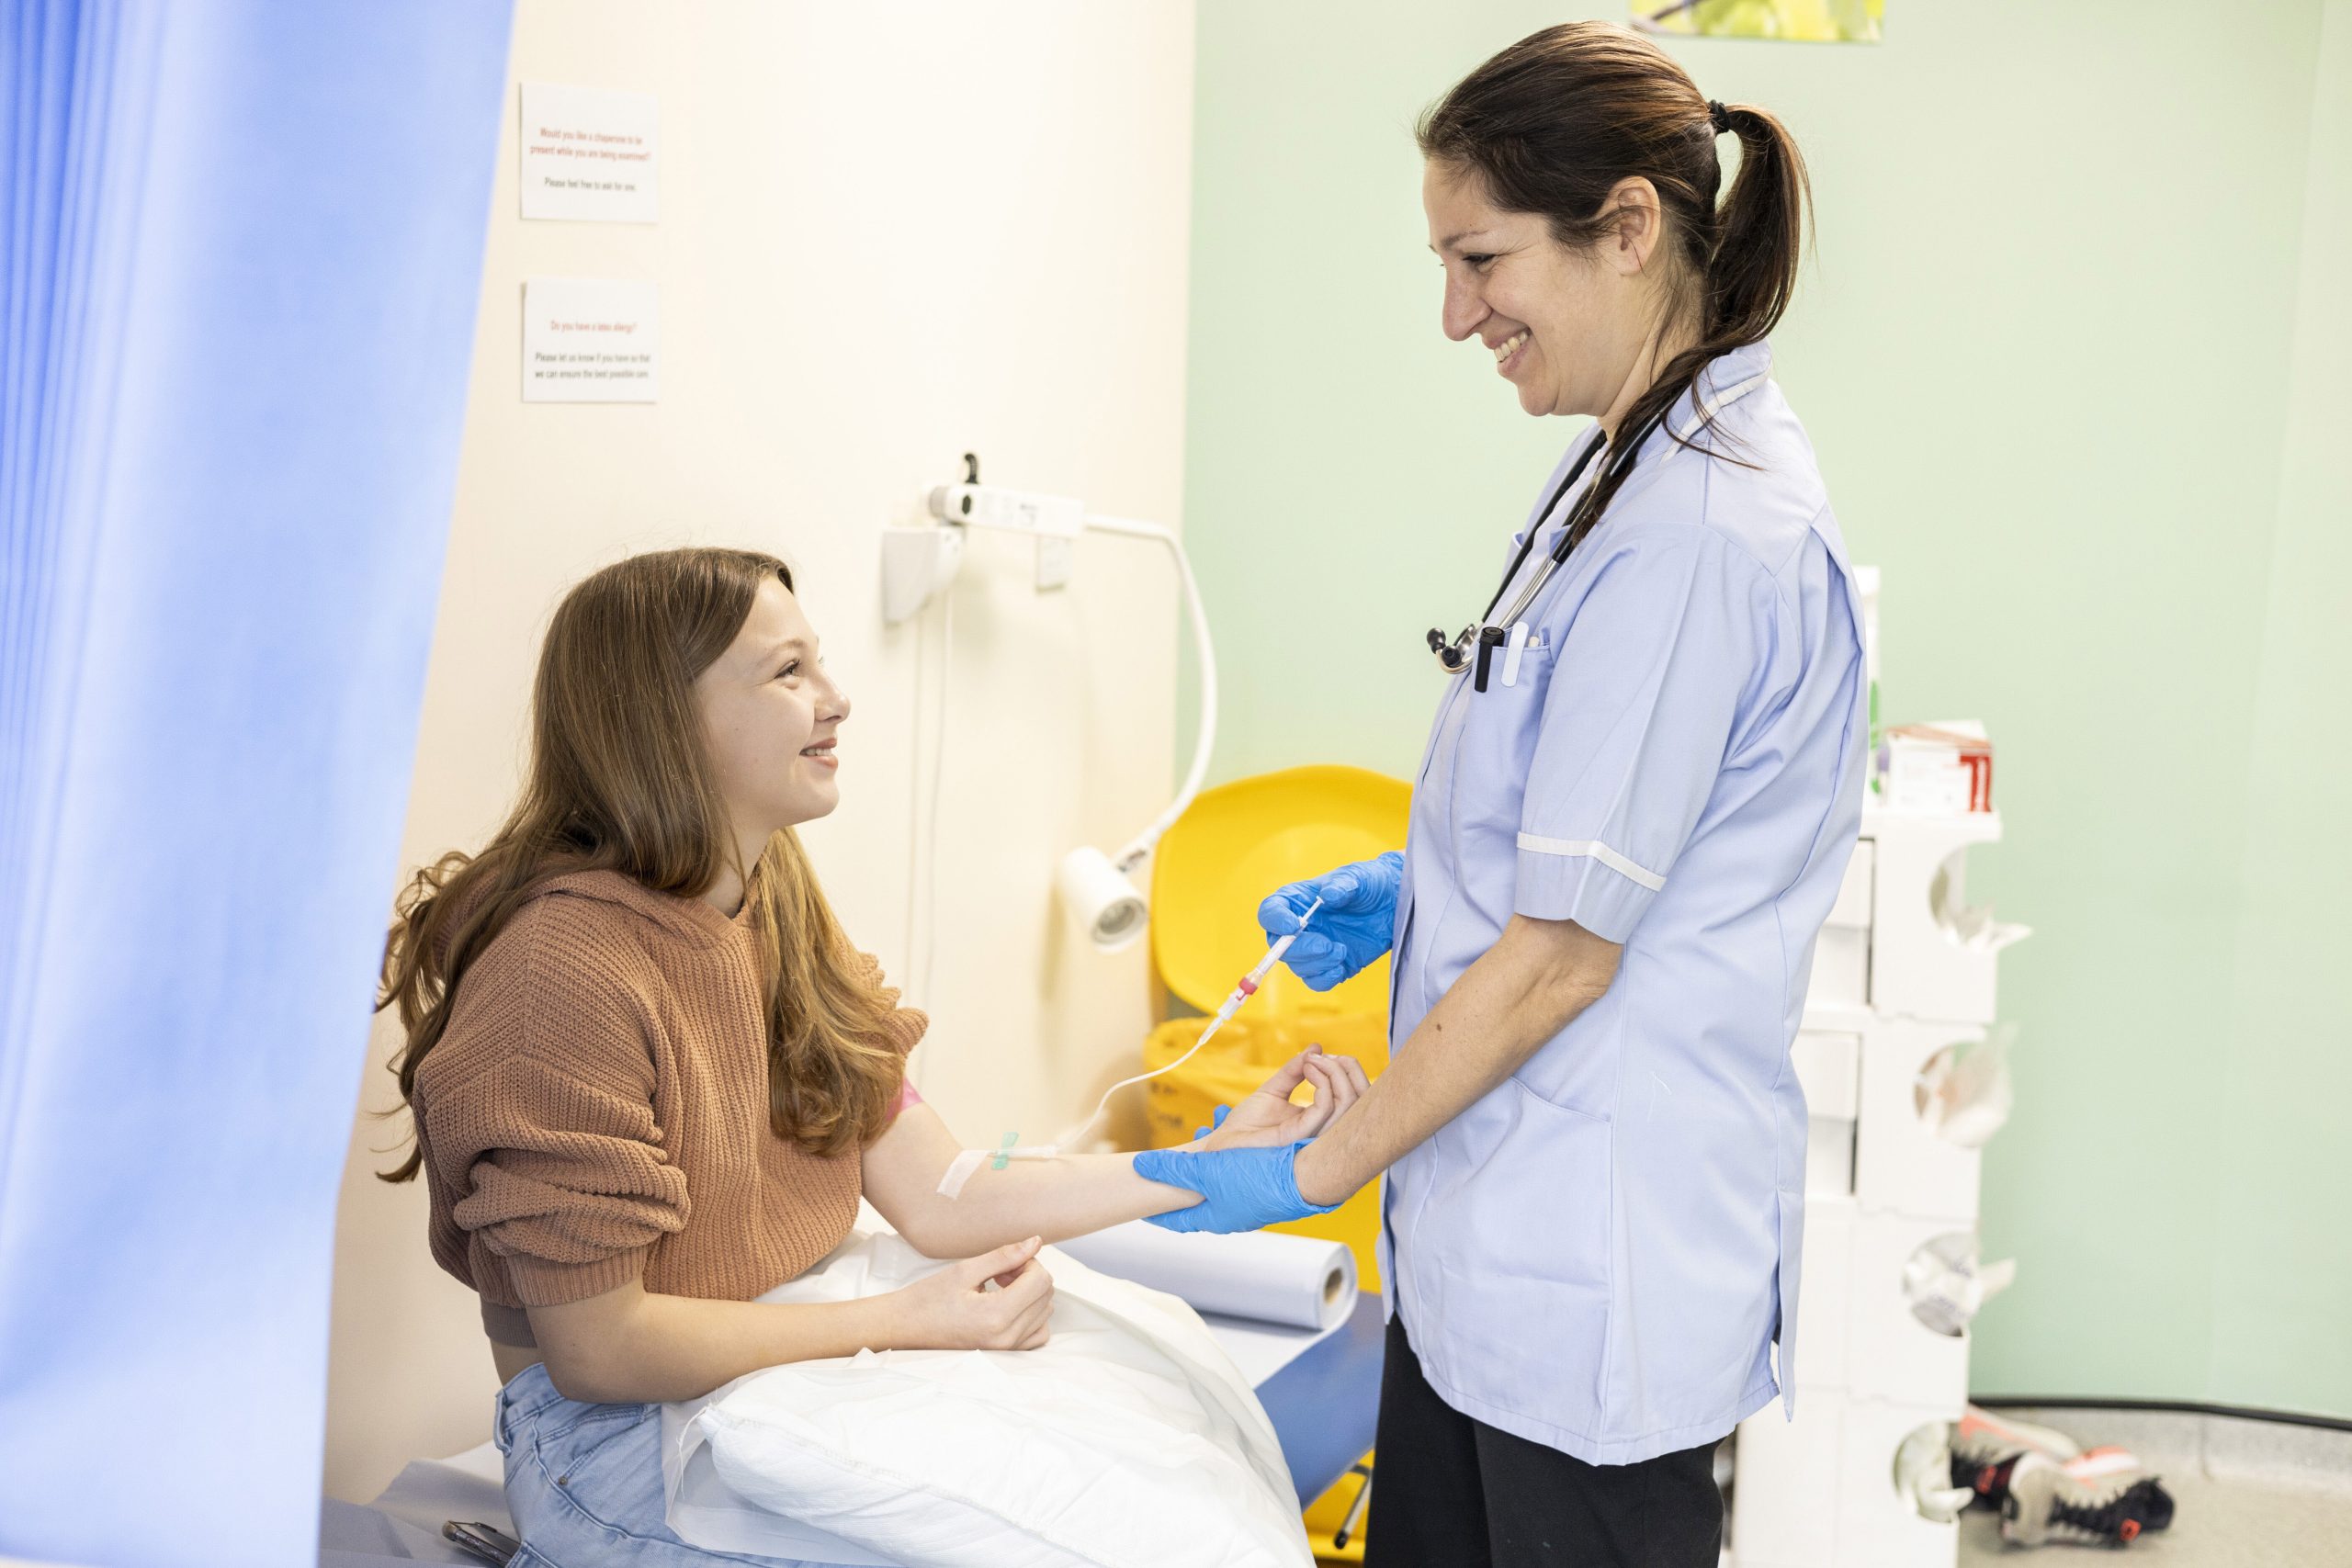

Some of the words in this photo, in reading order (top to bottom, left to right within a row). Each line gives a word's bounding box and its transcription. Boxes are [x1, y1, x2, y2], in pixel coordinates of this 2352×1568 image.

[540, 128, 560, 139] Would
[530, 146, 555, 155] present
[545, 176, 565, 187] Please
[536, 352, 557, 362] Please
